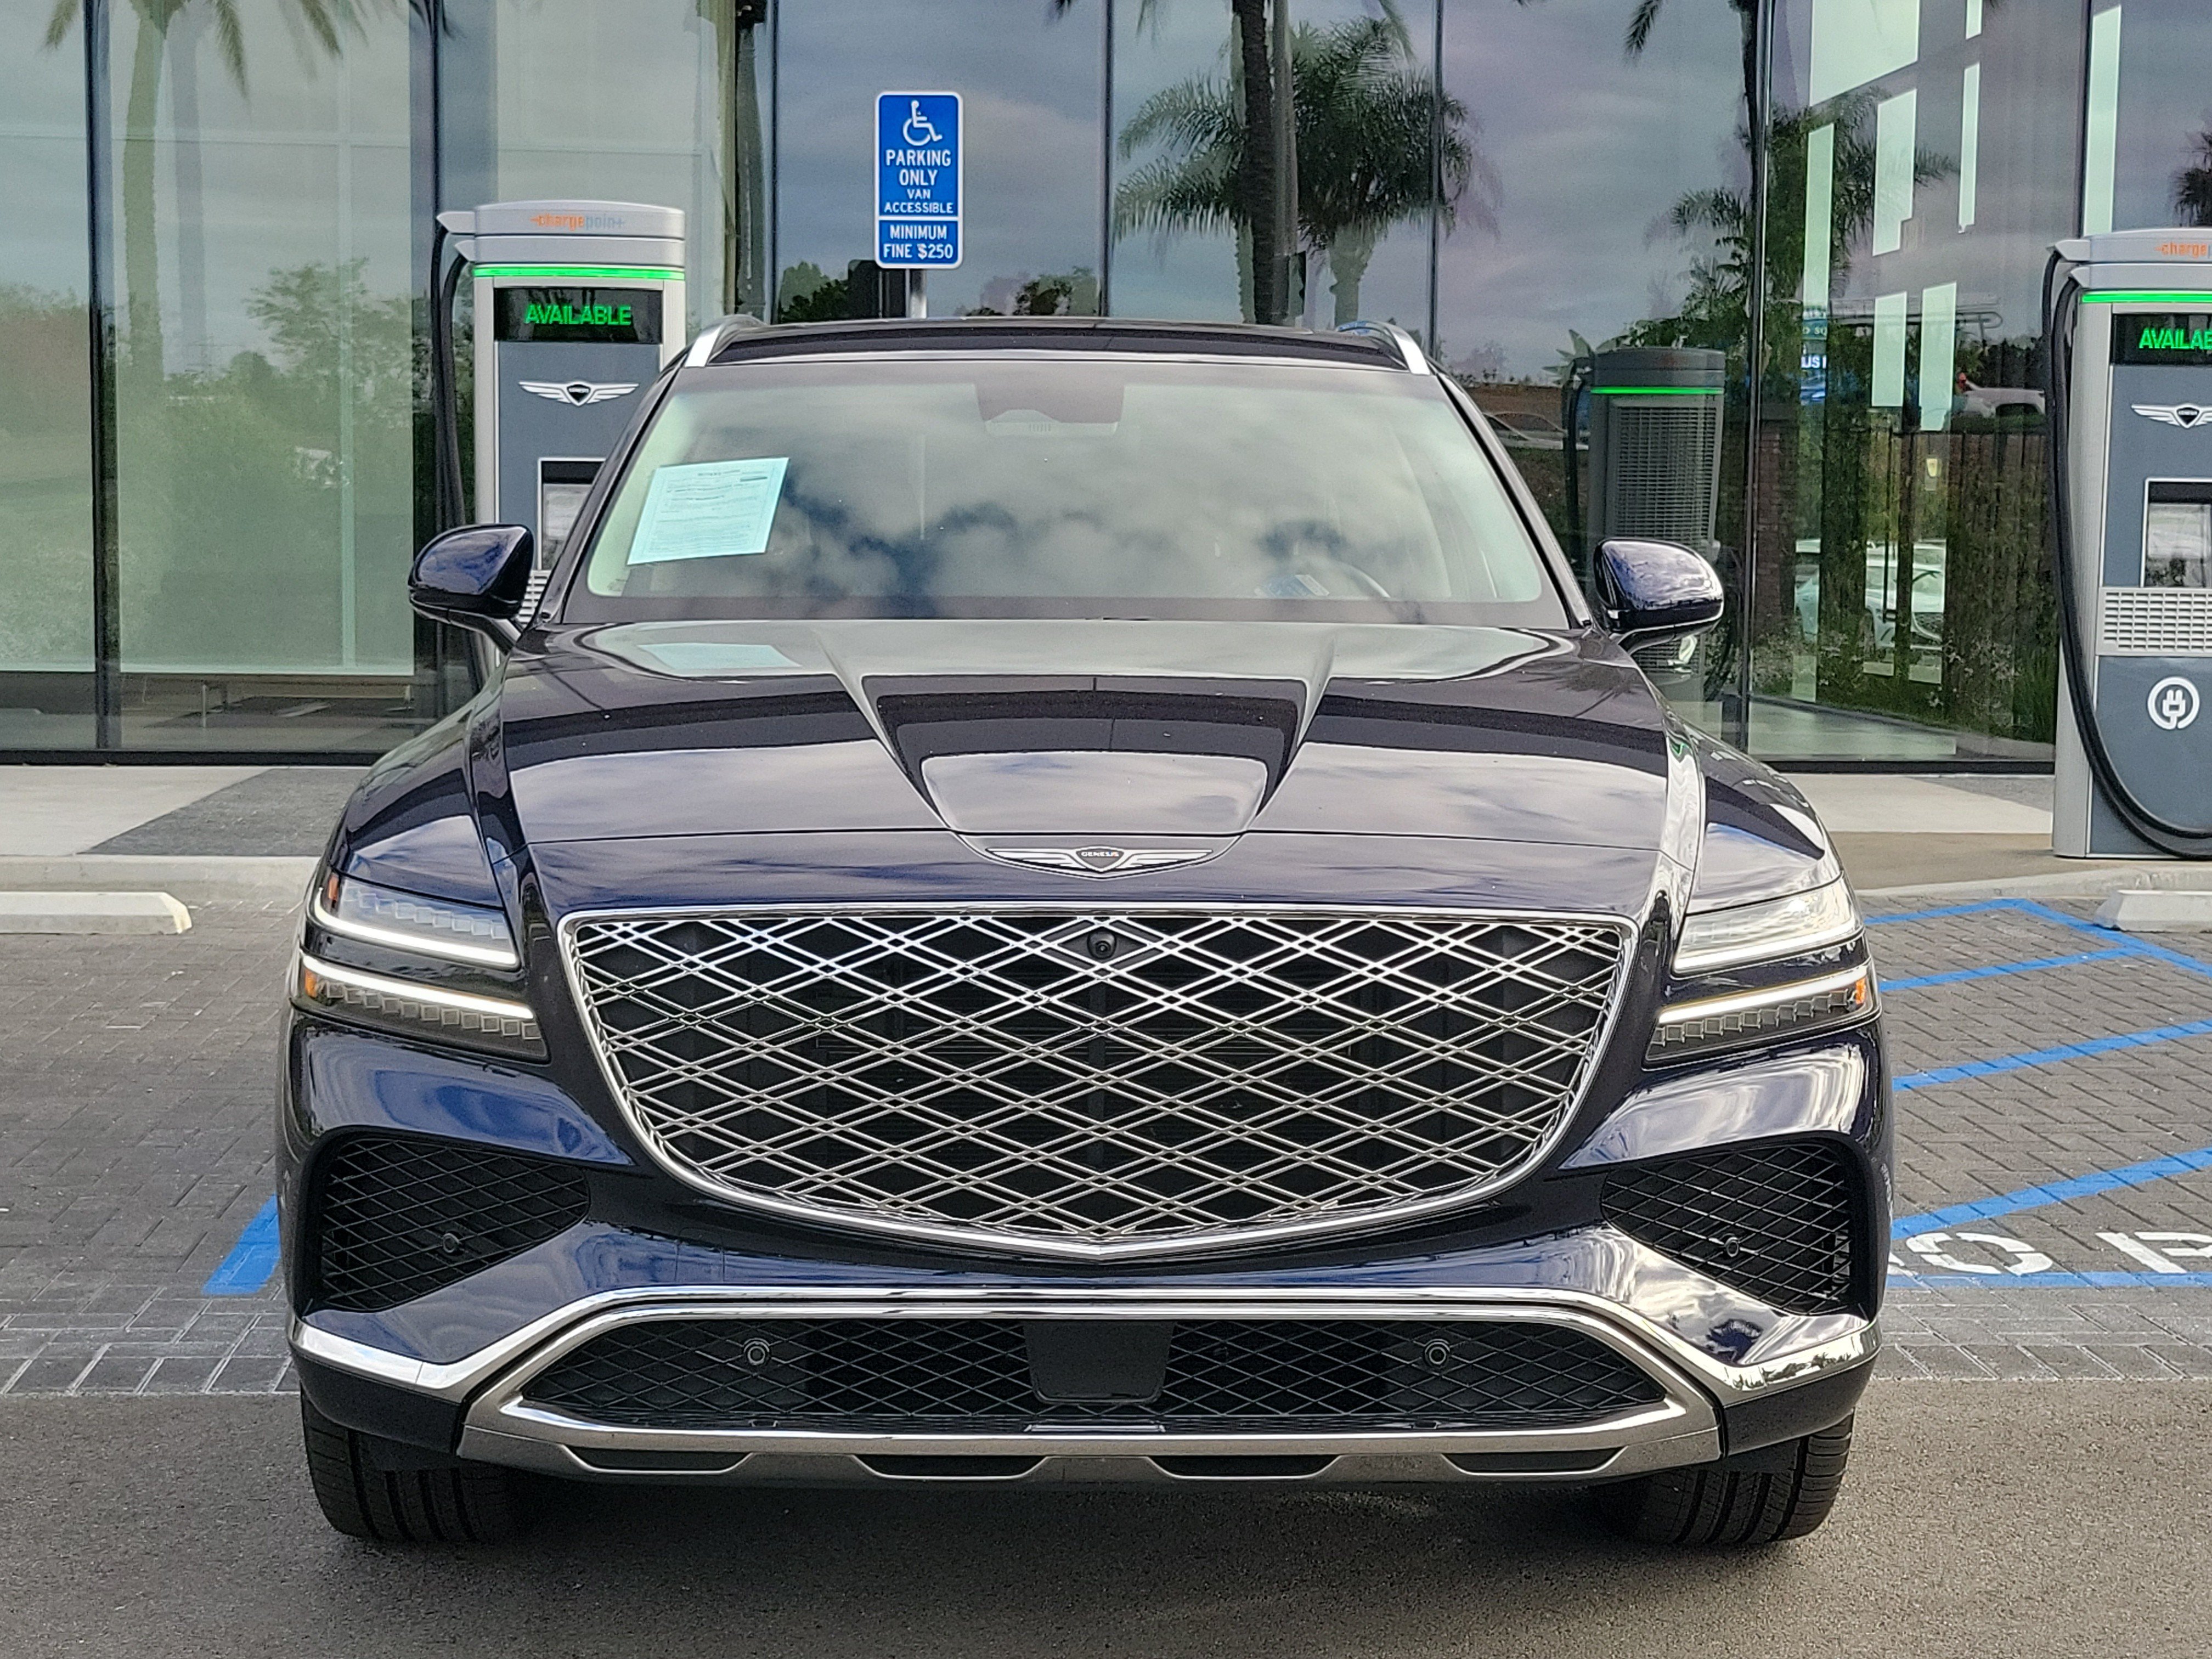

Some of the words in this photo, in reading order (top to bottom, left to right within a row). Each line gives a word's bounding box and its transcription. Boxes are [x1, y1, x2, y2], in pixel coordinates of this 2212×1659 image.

[885, 149, 951, 167] PARKING
[899, 170, 938, 185] ONLY
[907, 189, 930, 199] VAN
[884, 202, 953, 213] ACCESSIBLE
[890, 224, 947, 240] MINIMUM
[883, 244, 912, 258] FINE
[917, 243, 953, 259] $250
[524, 304, 631, 326] AVAILABLE
